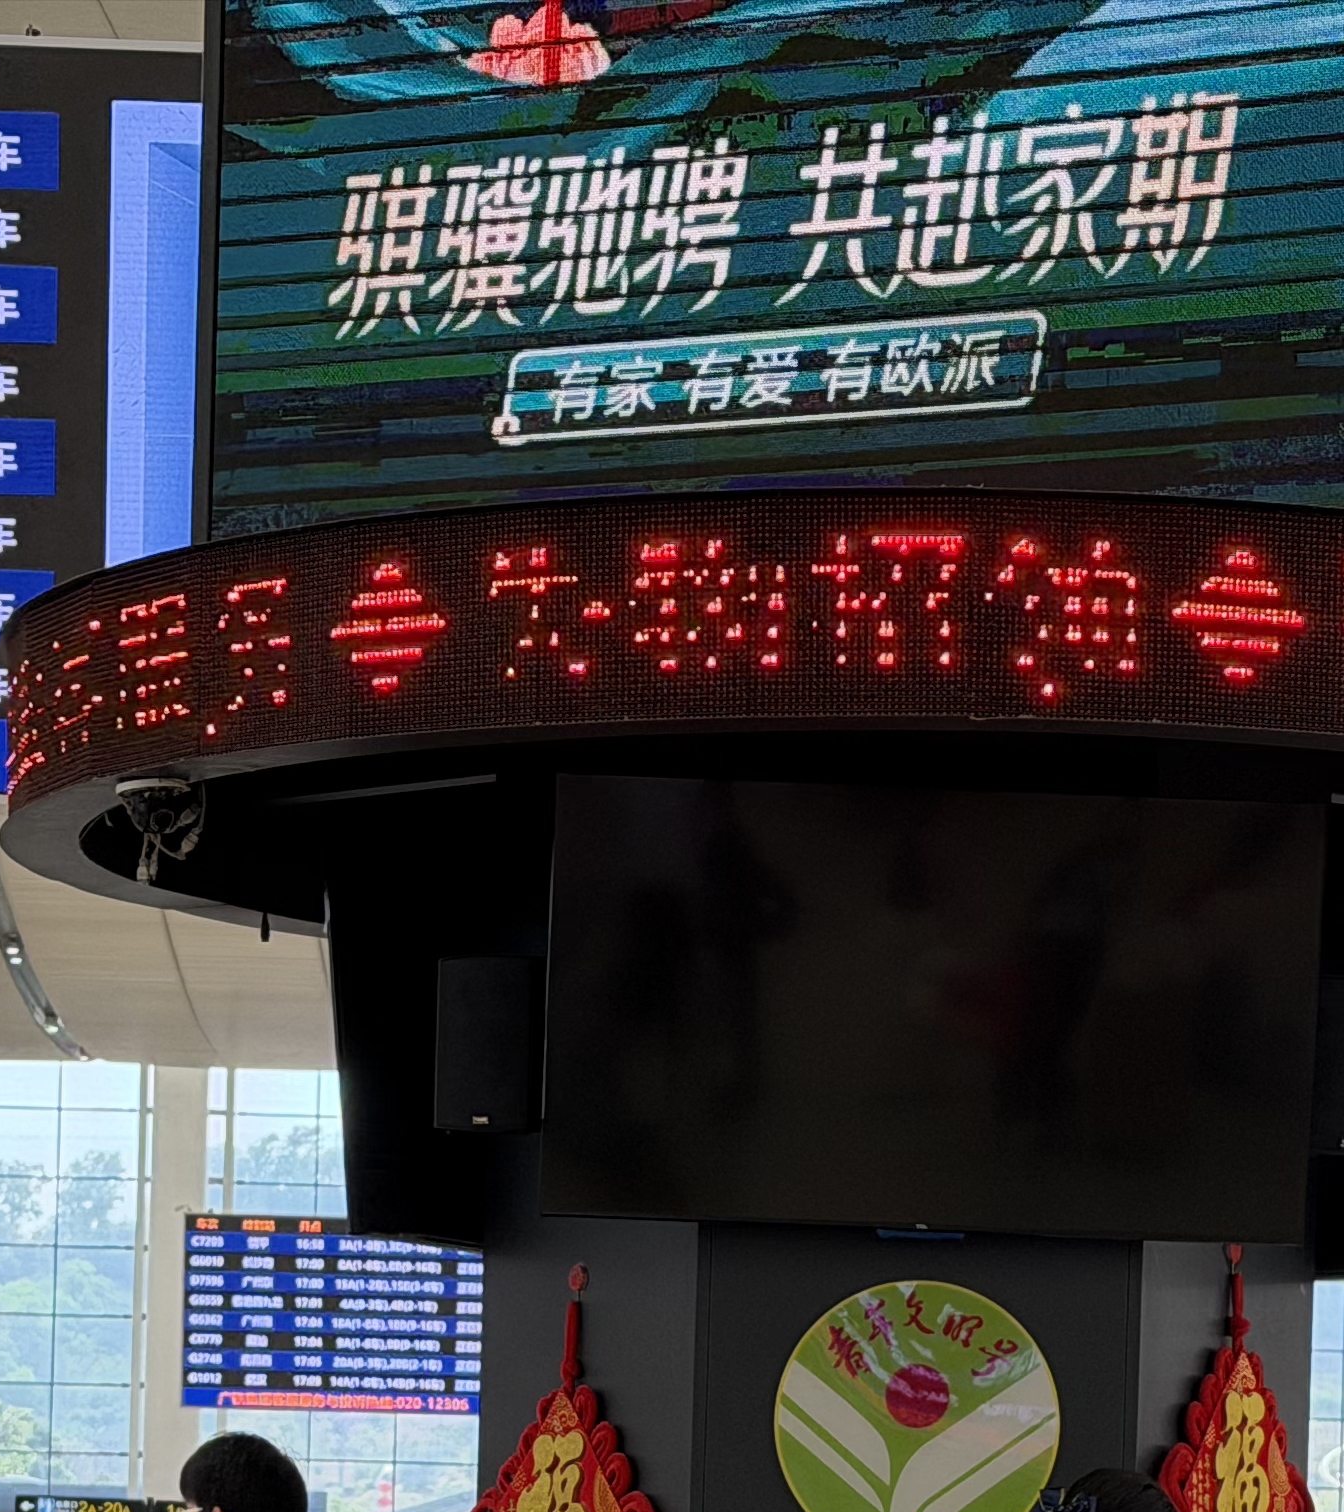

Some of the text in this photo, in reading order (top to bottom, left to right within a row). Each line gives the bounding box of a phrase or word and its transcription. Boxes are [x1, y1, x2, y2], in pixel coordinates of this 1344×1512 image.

[774, 92, 1240, 310] 共赴家期
[550, 329, 1006, 424] 有家 有爱 有欧派
